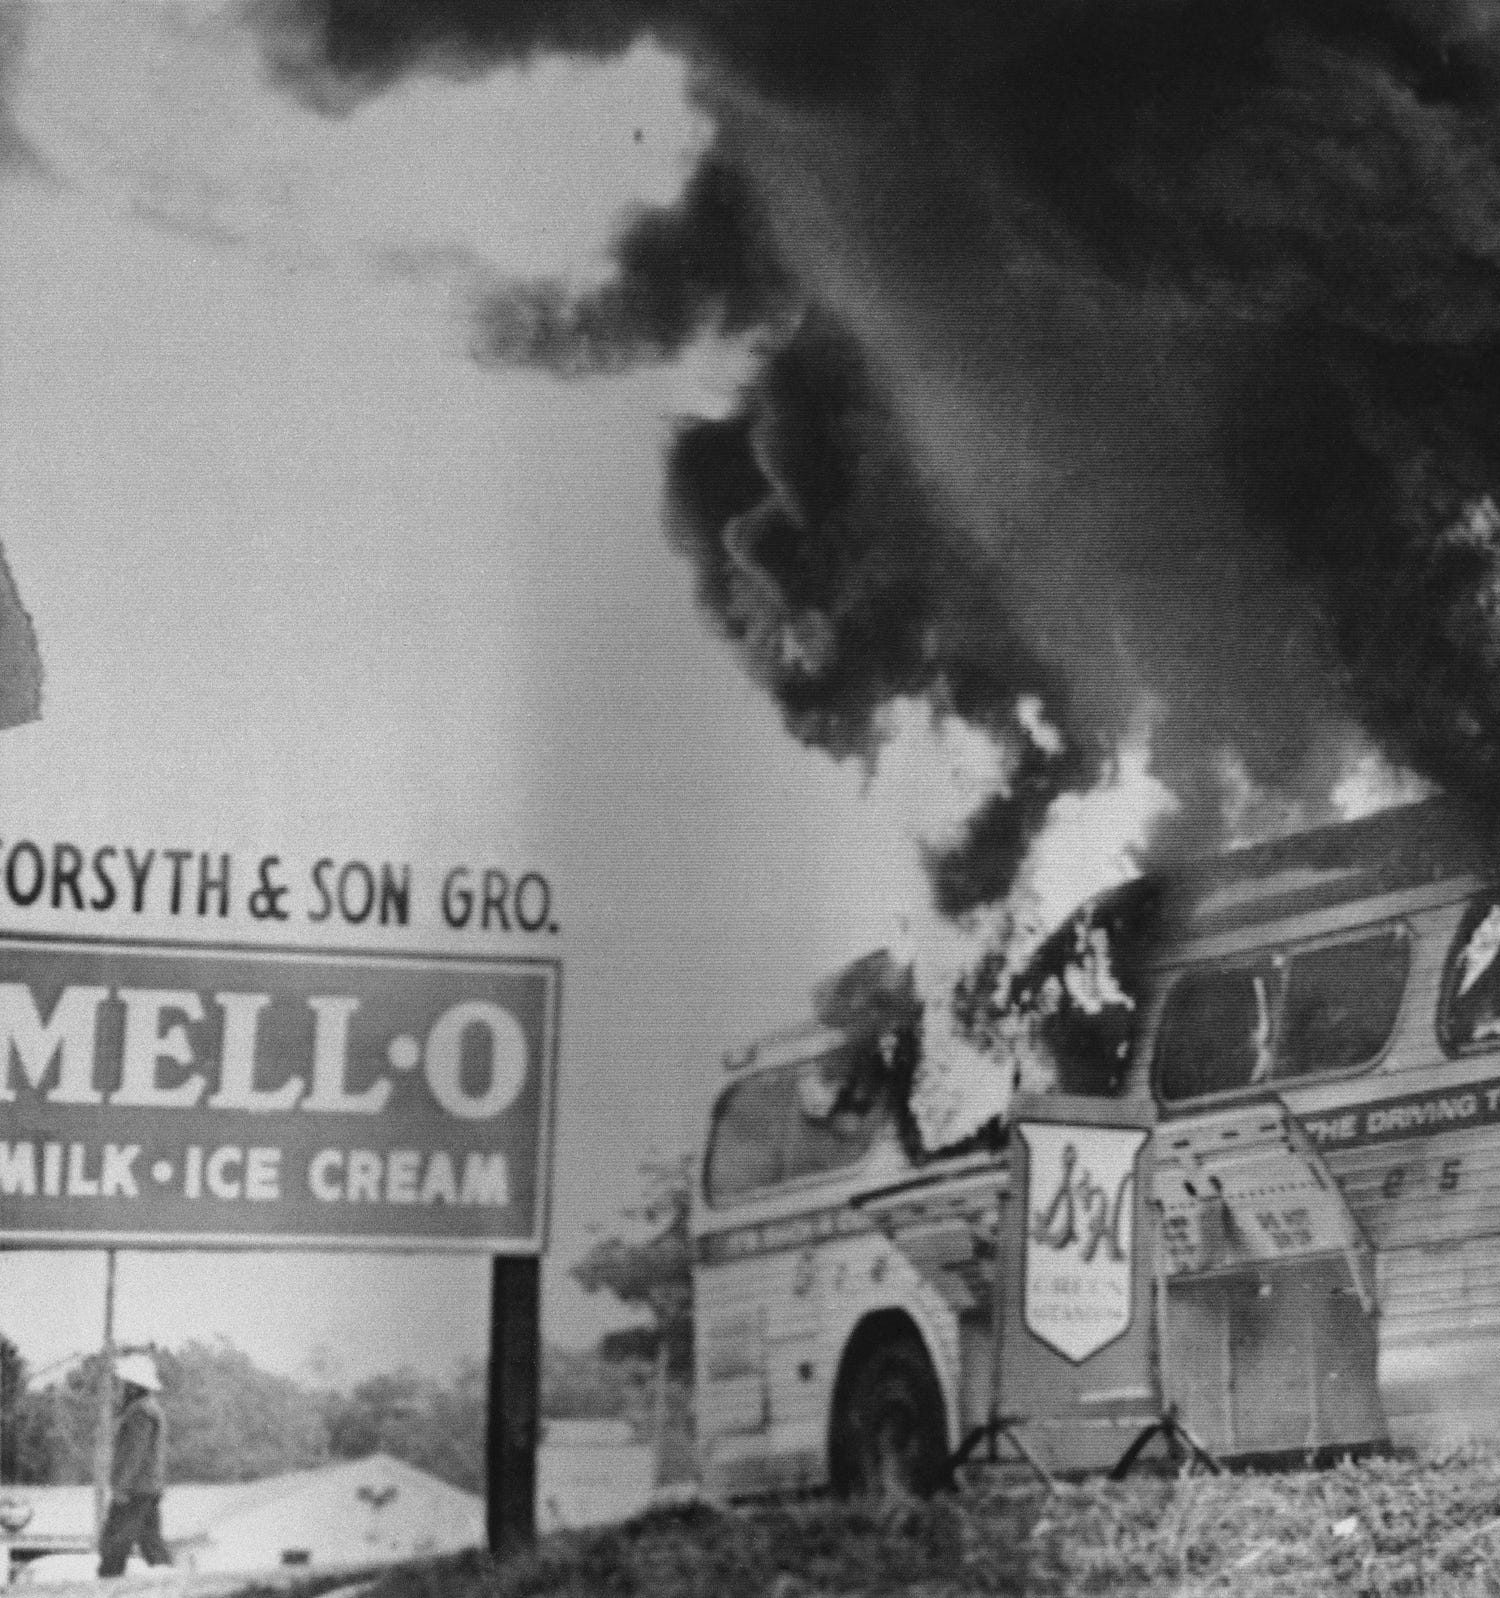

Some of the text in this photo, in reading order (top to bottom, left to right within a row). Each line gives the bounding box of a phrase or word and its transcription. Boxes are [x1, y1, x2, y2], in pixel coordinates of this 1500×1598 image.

[0, 838, 560, 935] ORSYTH & SON GRO.
[1304, 1113, 1357, 1141] THE
[1366, 1093, 1478, 1134] DRIVING
[308, 1147, 509, 1206] CREAM
